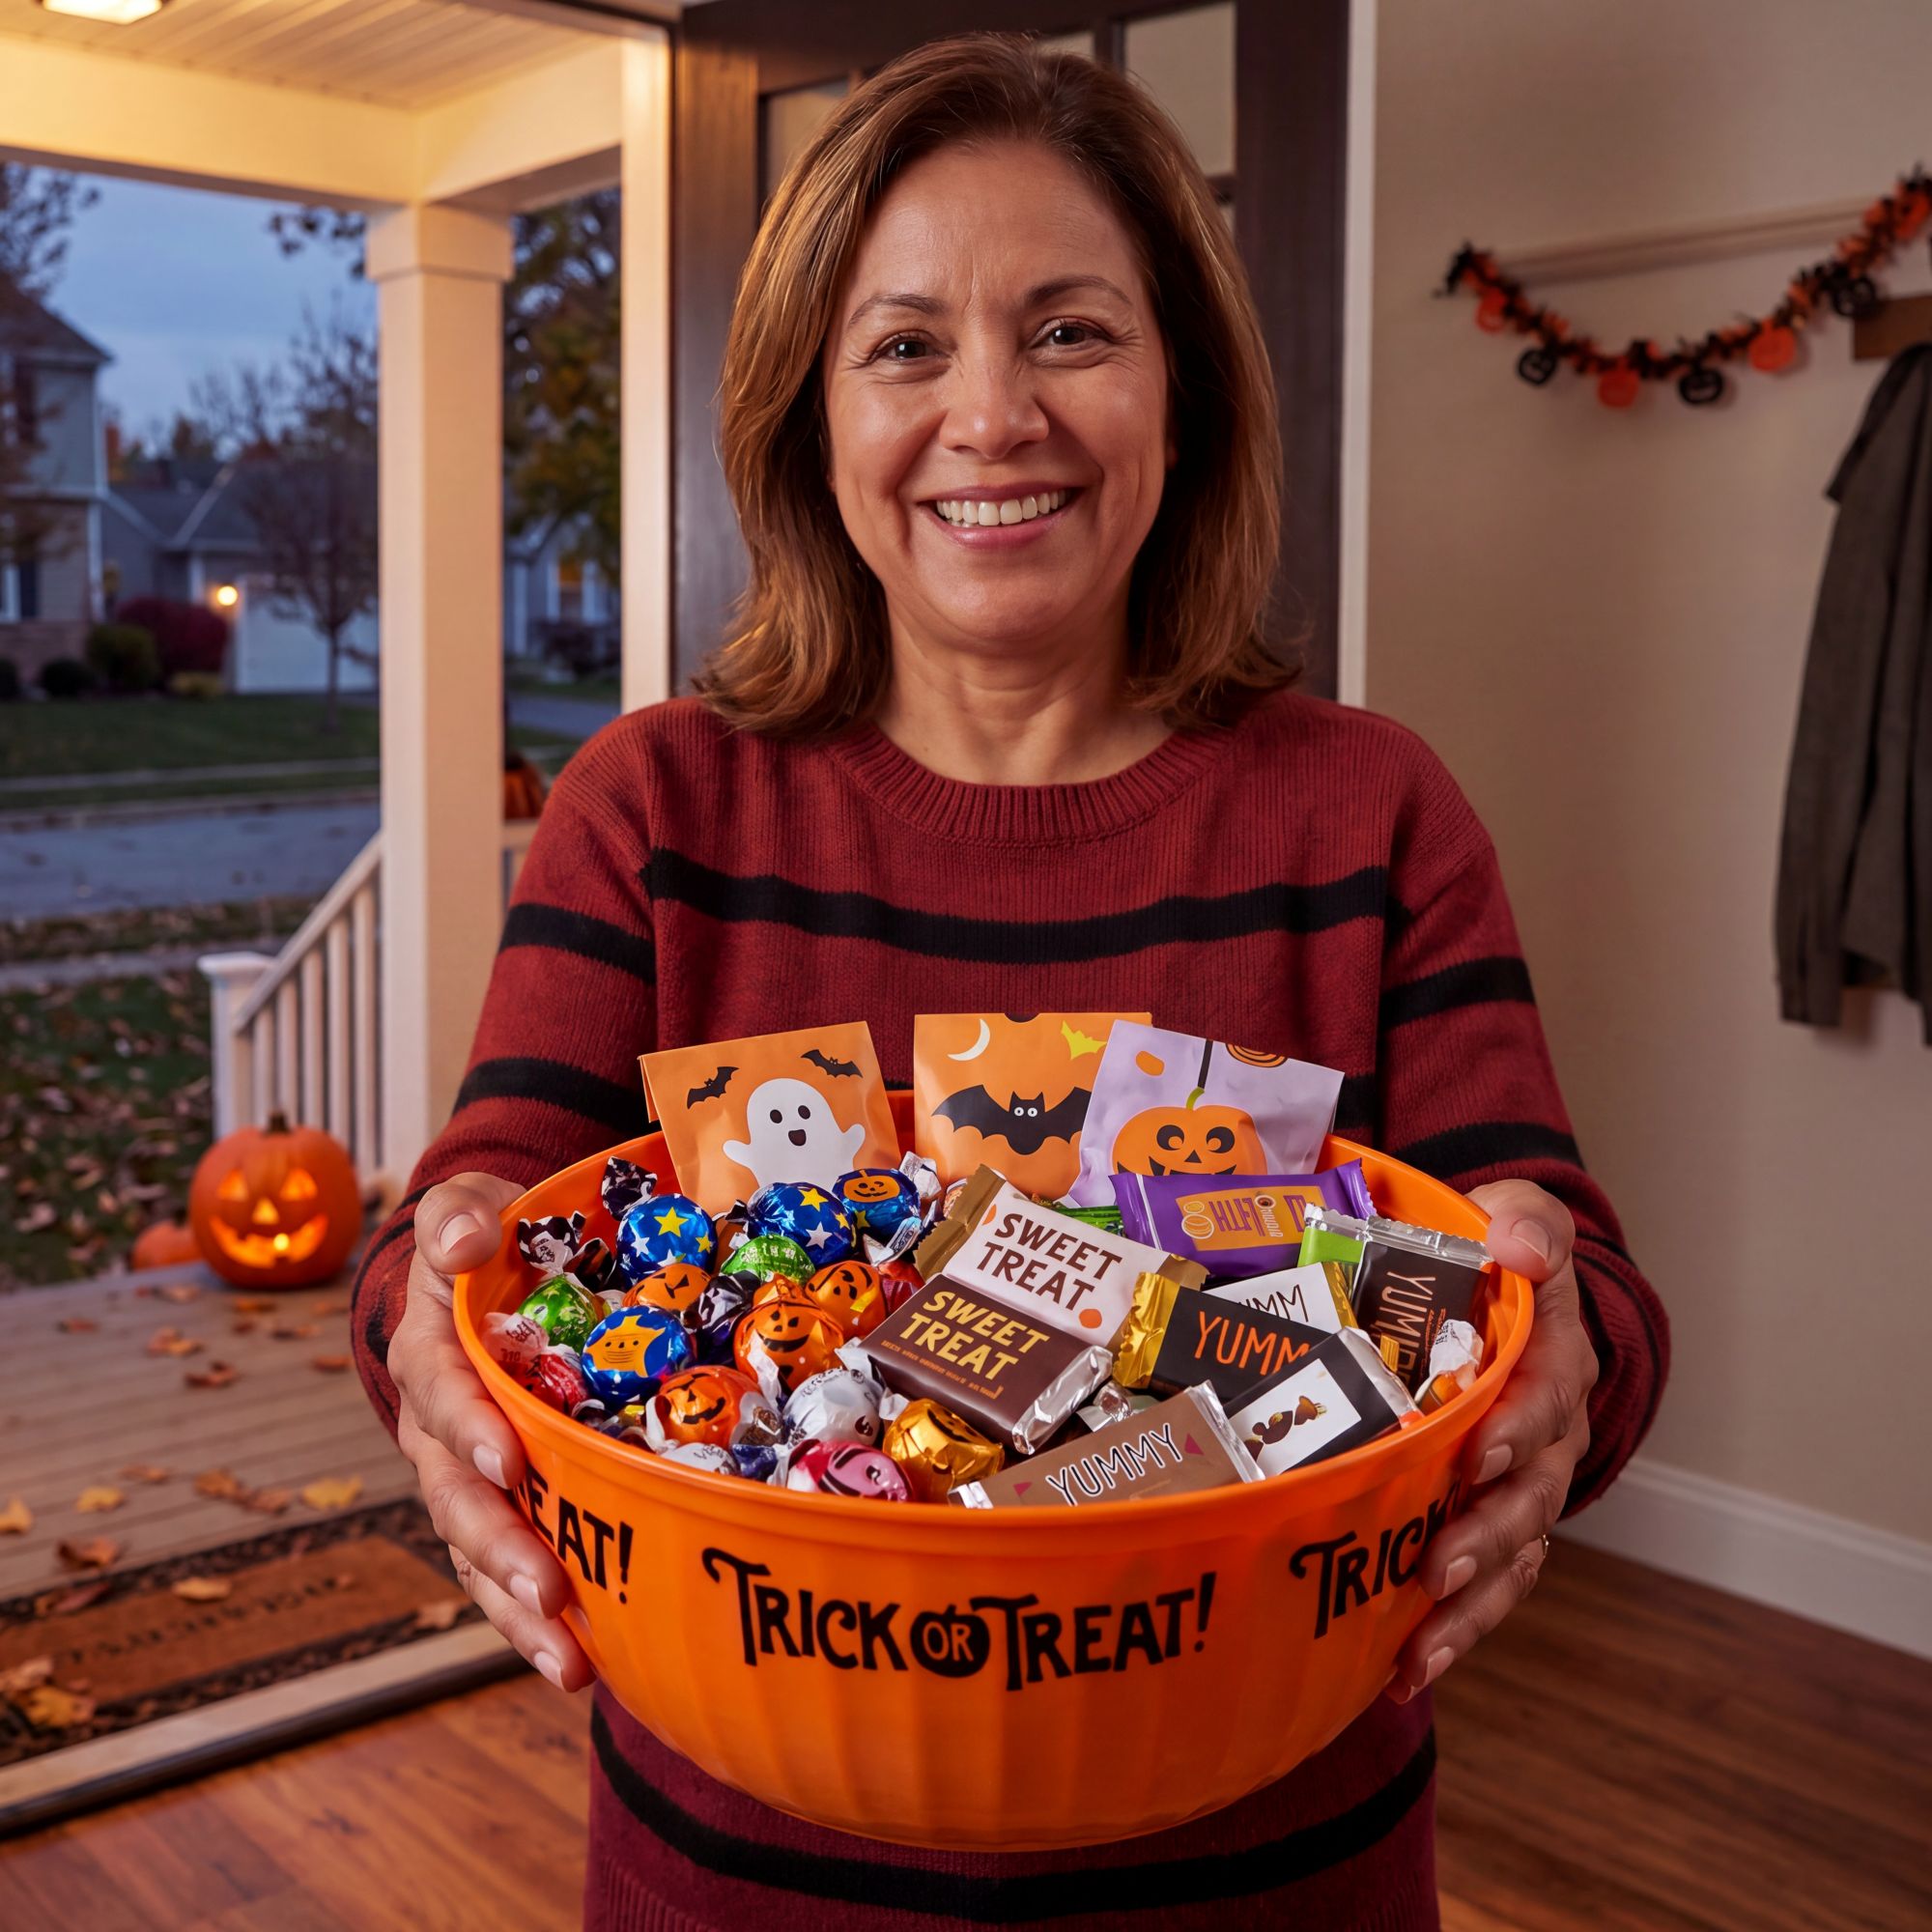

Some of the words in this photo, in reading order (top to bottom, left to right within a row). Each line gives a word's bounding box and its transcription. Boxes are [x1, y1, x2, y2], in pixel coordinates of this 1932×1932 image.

[977, 1241, 1095, 1312] TREAT
[994, 1213, 1122, 1280] SWEET
[899, 1312, 1019, 1380] TREAT
[923, 1291, 1050, 1353] SWEET
[1045, 1423, 1182, 1506] YUMMY
[515, 1462, 634, 1605] EAT!
[702, 1548, 909, 1670] TRICK
[969, 1571, 1217, 1691] TREAT!
